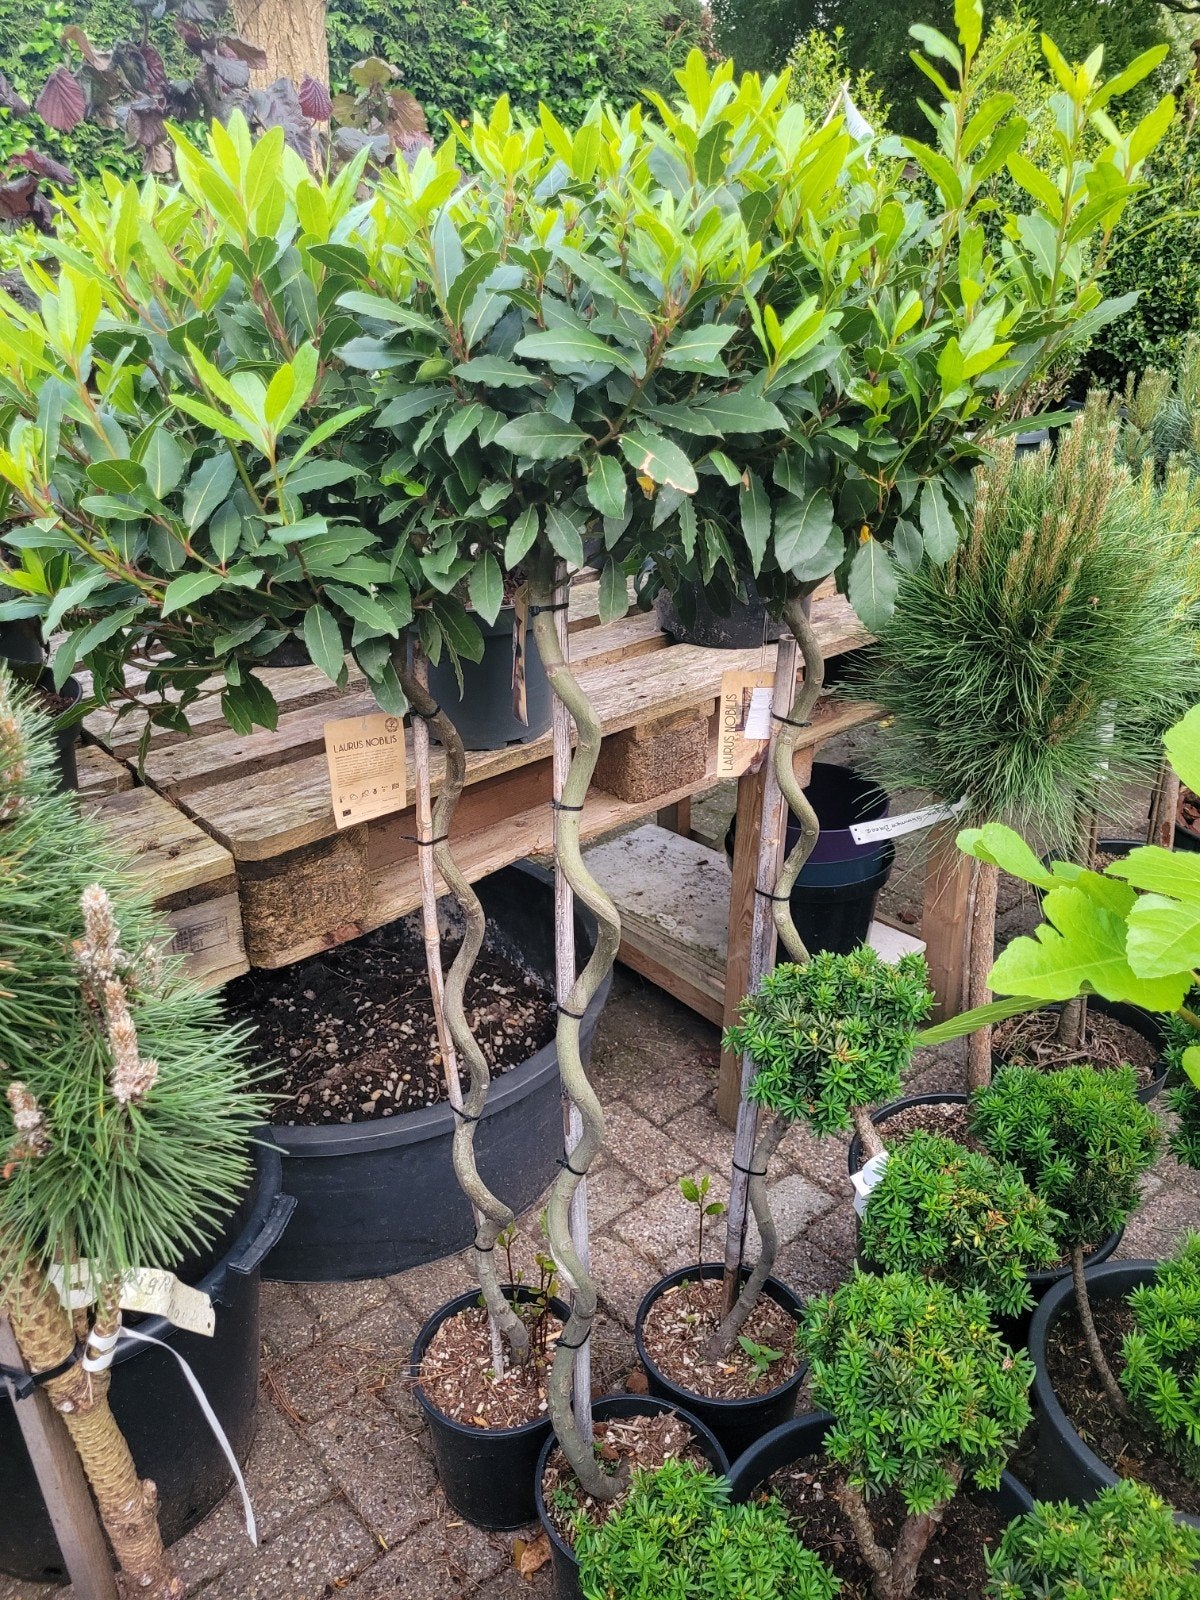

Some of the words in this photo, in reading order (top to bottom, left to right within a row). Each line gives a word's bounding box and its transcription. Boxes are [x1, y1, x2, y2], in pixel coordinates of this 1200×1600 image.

[724, 693, 737, 732] NOBILIS
[333, 741, 363, 753] LAURUS
[366, 735, 397, 747] NOBILIS
[722, 735, 735, 771] LAURUS
